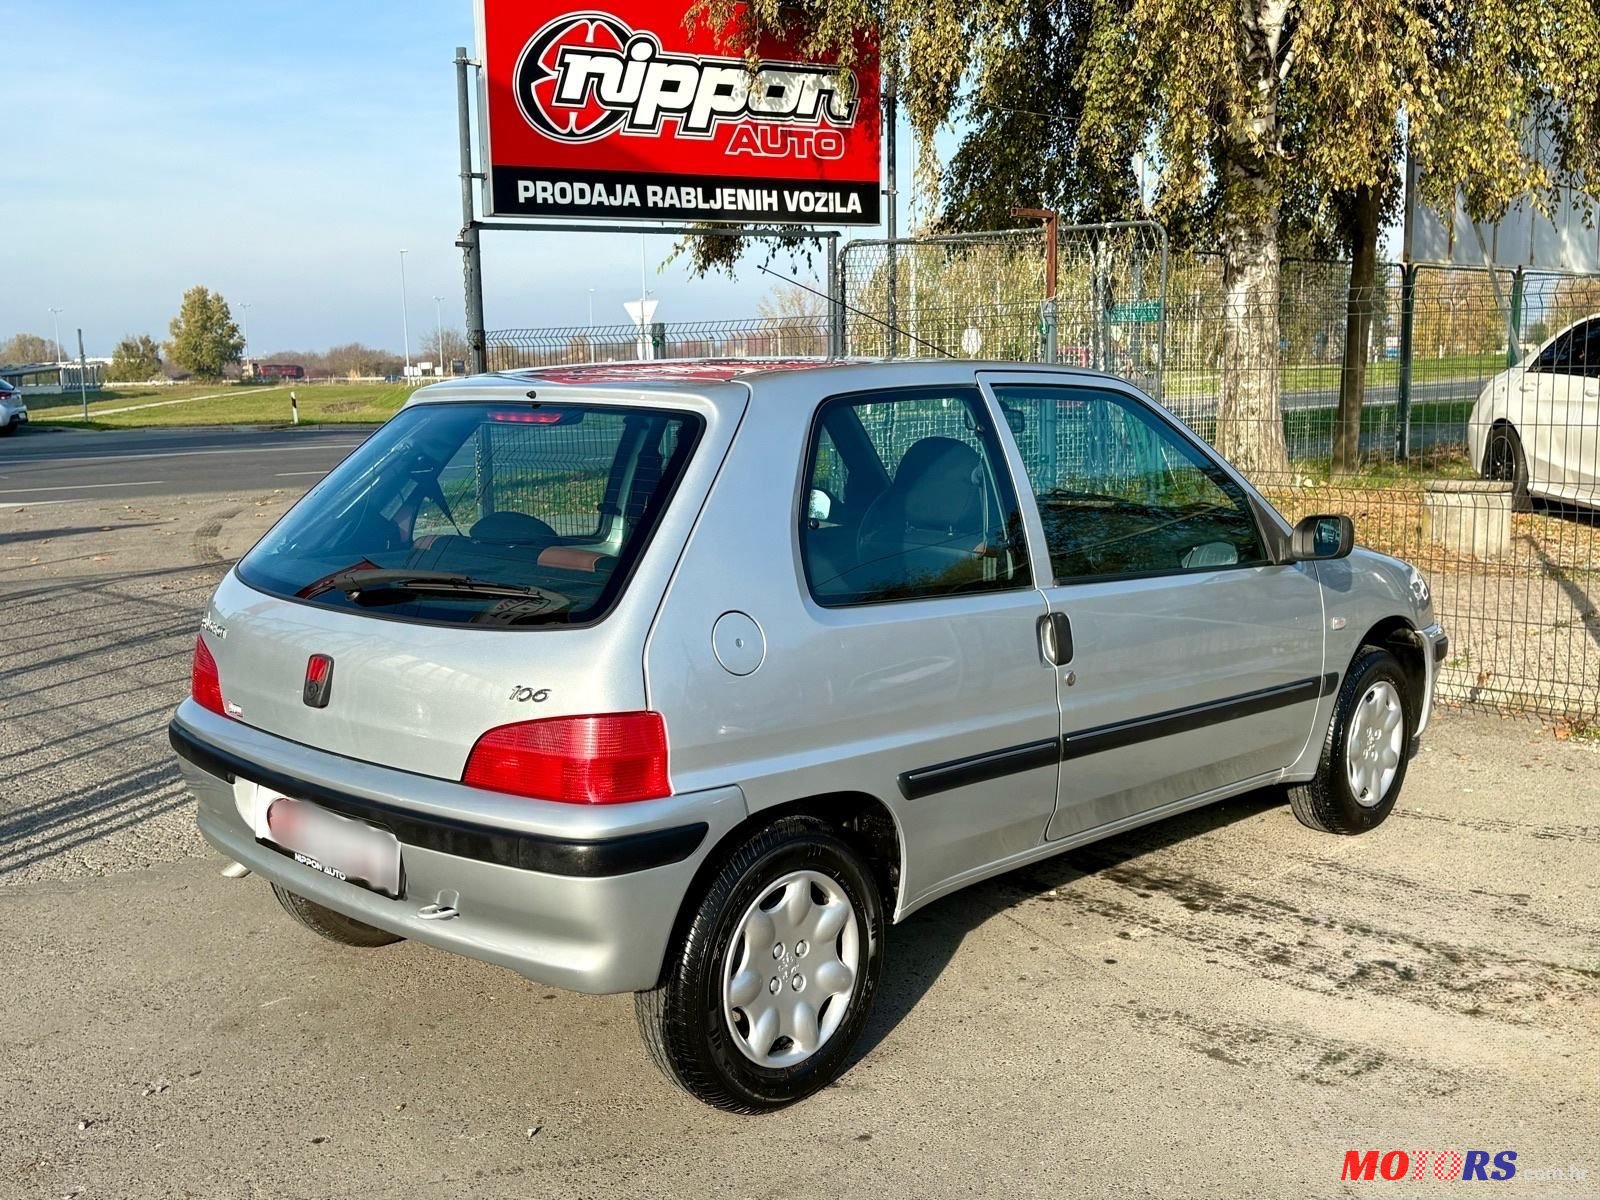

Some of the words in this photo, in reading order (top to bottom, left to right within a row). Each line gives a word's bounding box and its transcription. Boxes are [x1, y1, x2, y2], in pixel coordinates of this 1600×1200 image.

[555, 33, 858, 134] nippon
[724, 125, 845, 160] AUTO
[517, 179, 640, 207] PRODAJA
[648, 185, 779, 212] RABLJENIH
[784, 191, 862, 214] VOZILA
[509, 684, 553, 703] 106
[294, 852, 323, 872] NIPPON
[323, 866, 346, 881] AUTO
